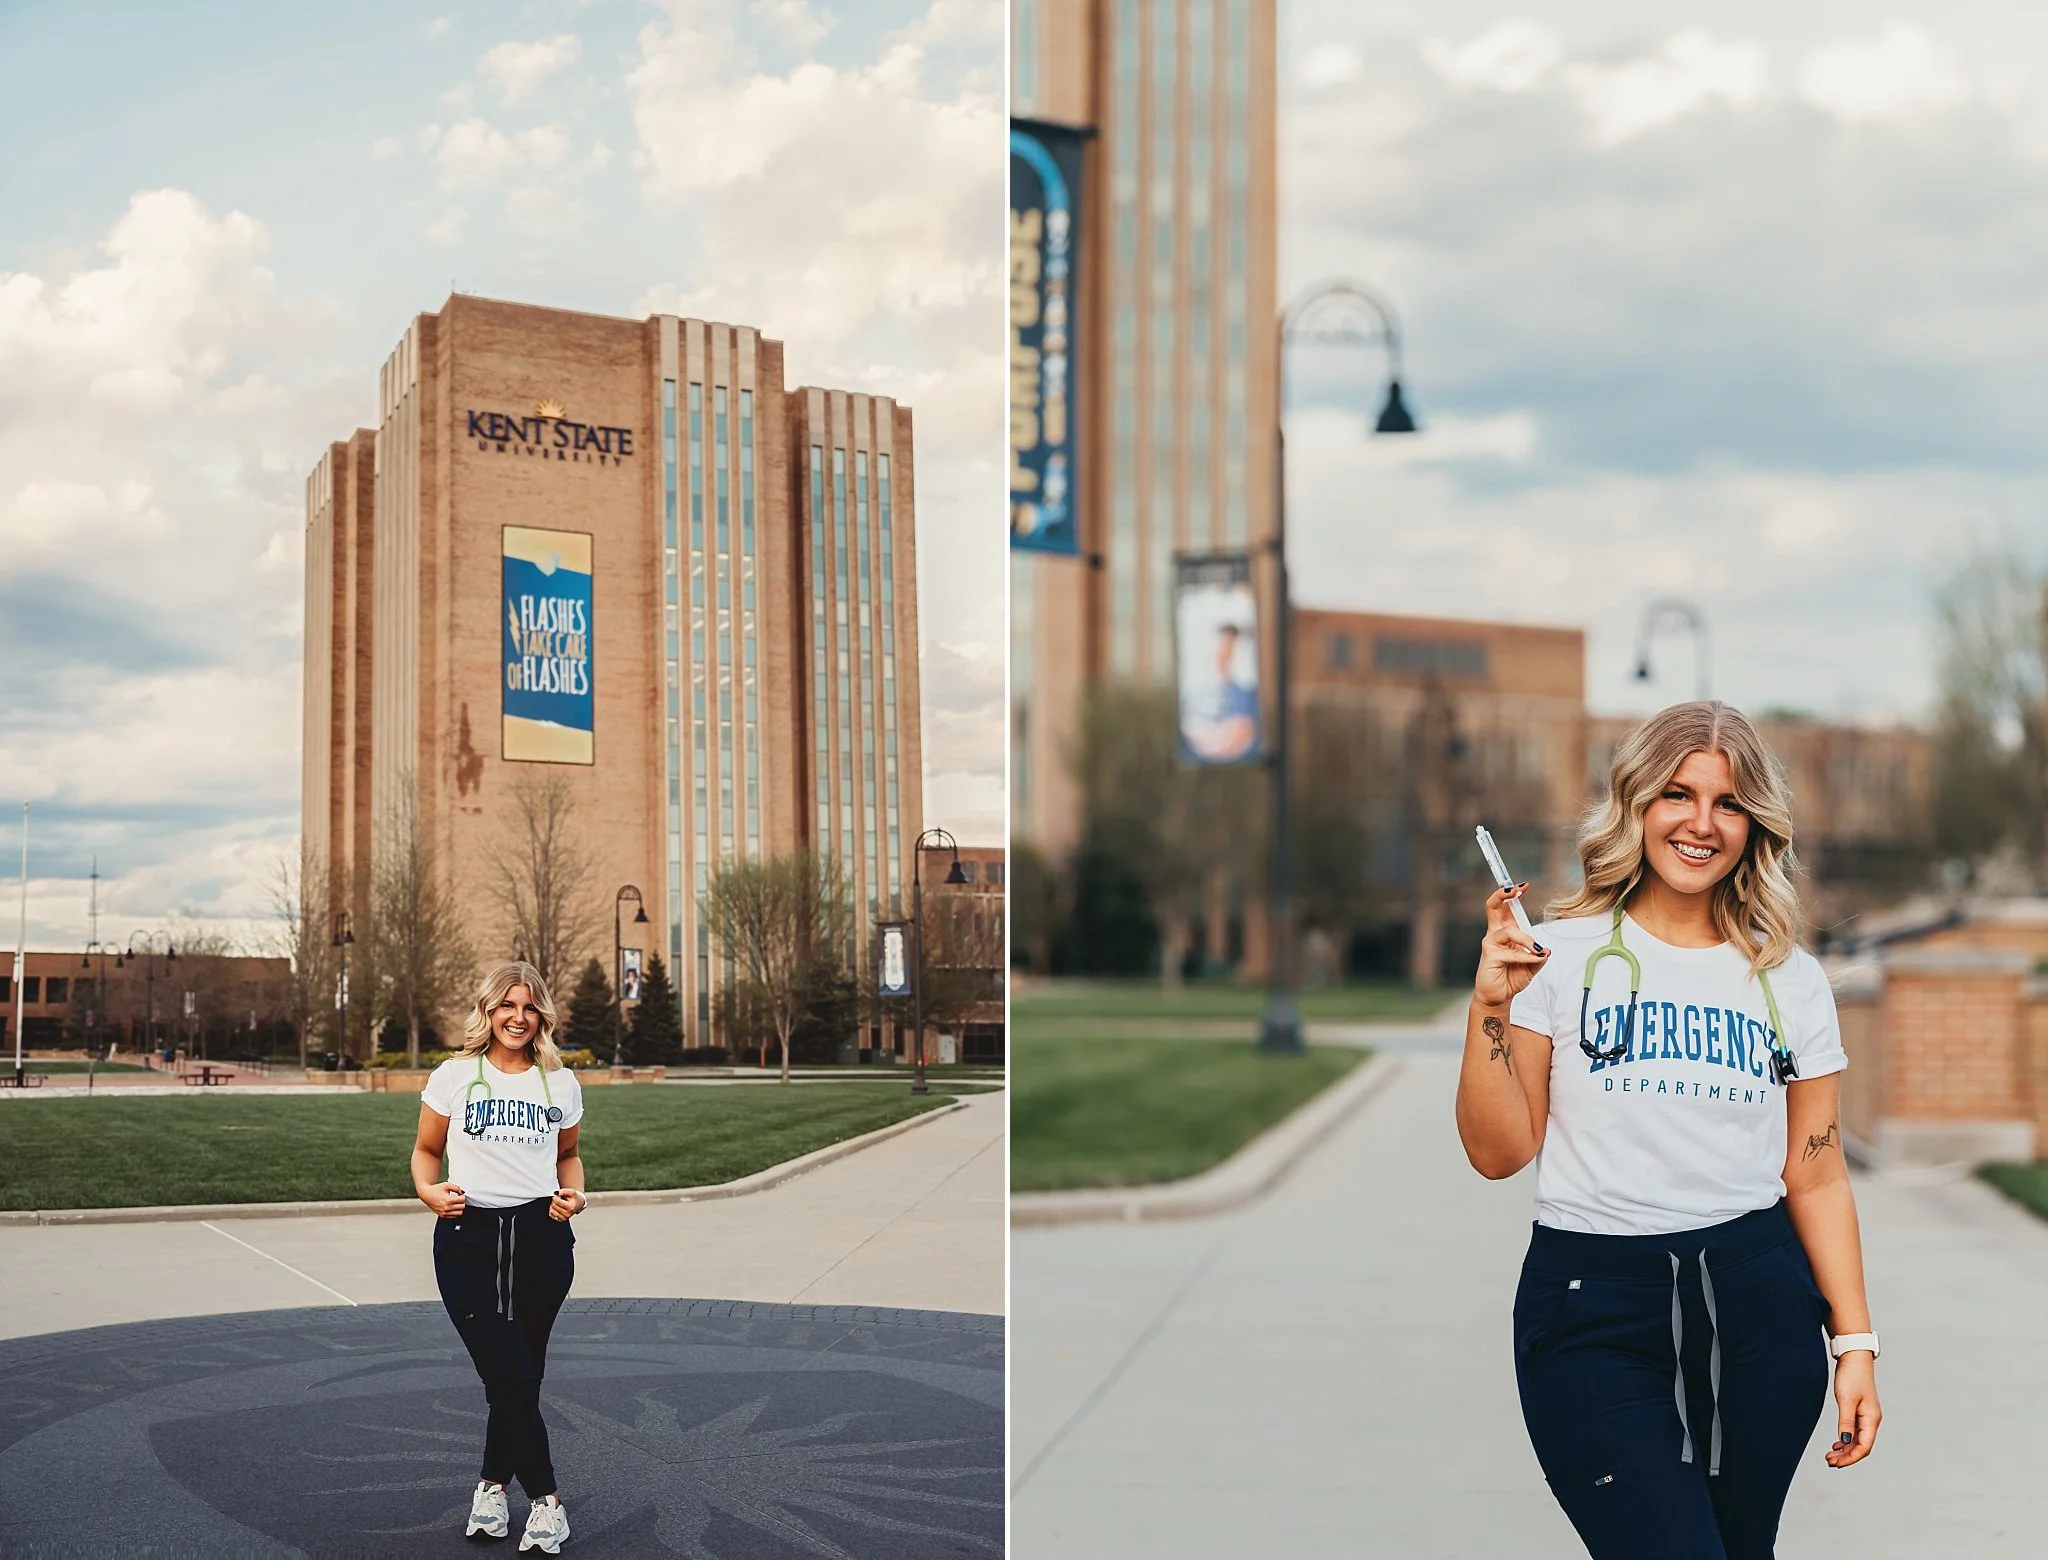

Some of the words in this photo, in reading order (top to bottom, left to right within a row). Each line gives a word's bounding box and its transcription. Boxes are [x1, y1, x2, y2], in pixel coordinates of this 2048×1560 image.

[467, 409, 548, 445] KENT
[553, 420, 633, 456] STATE
[478, 440, 622, 467] UNIVERSITY
[520, 595, 587, 634] FLASHES
[522, 629, 553, 658] TAKE
[555, 632, 587, 661] CARE
[507, 662, 522, 691] OF
[522, 655, 589, 695] FLASHES
[1605, 1078, 1766, 1104] DEPARTMENT
[471, 1134, 546, 1144] DEPARTMENT
